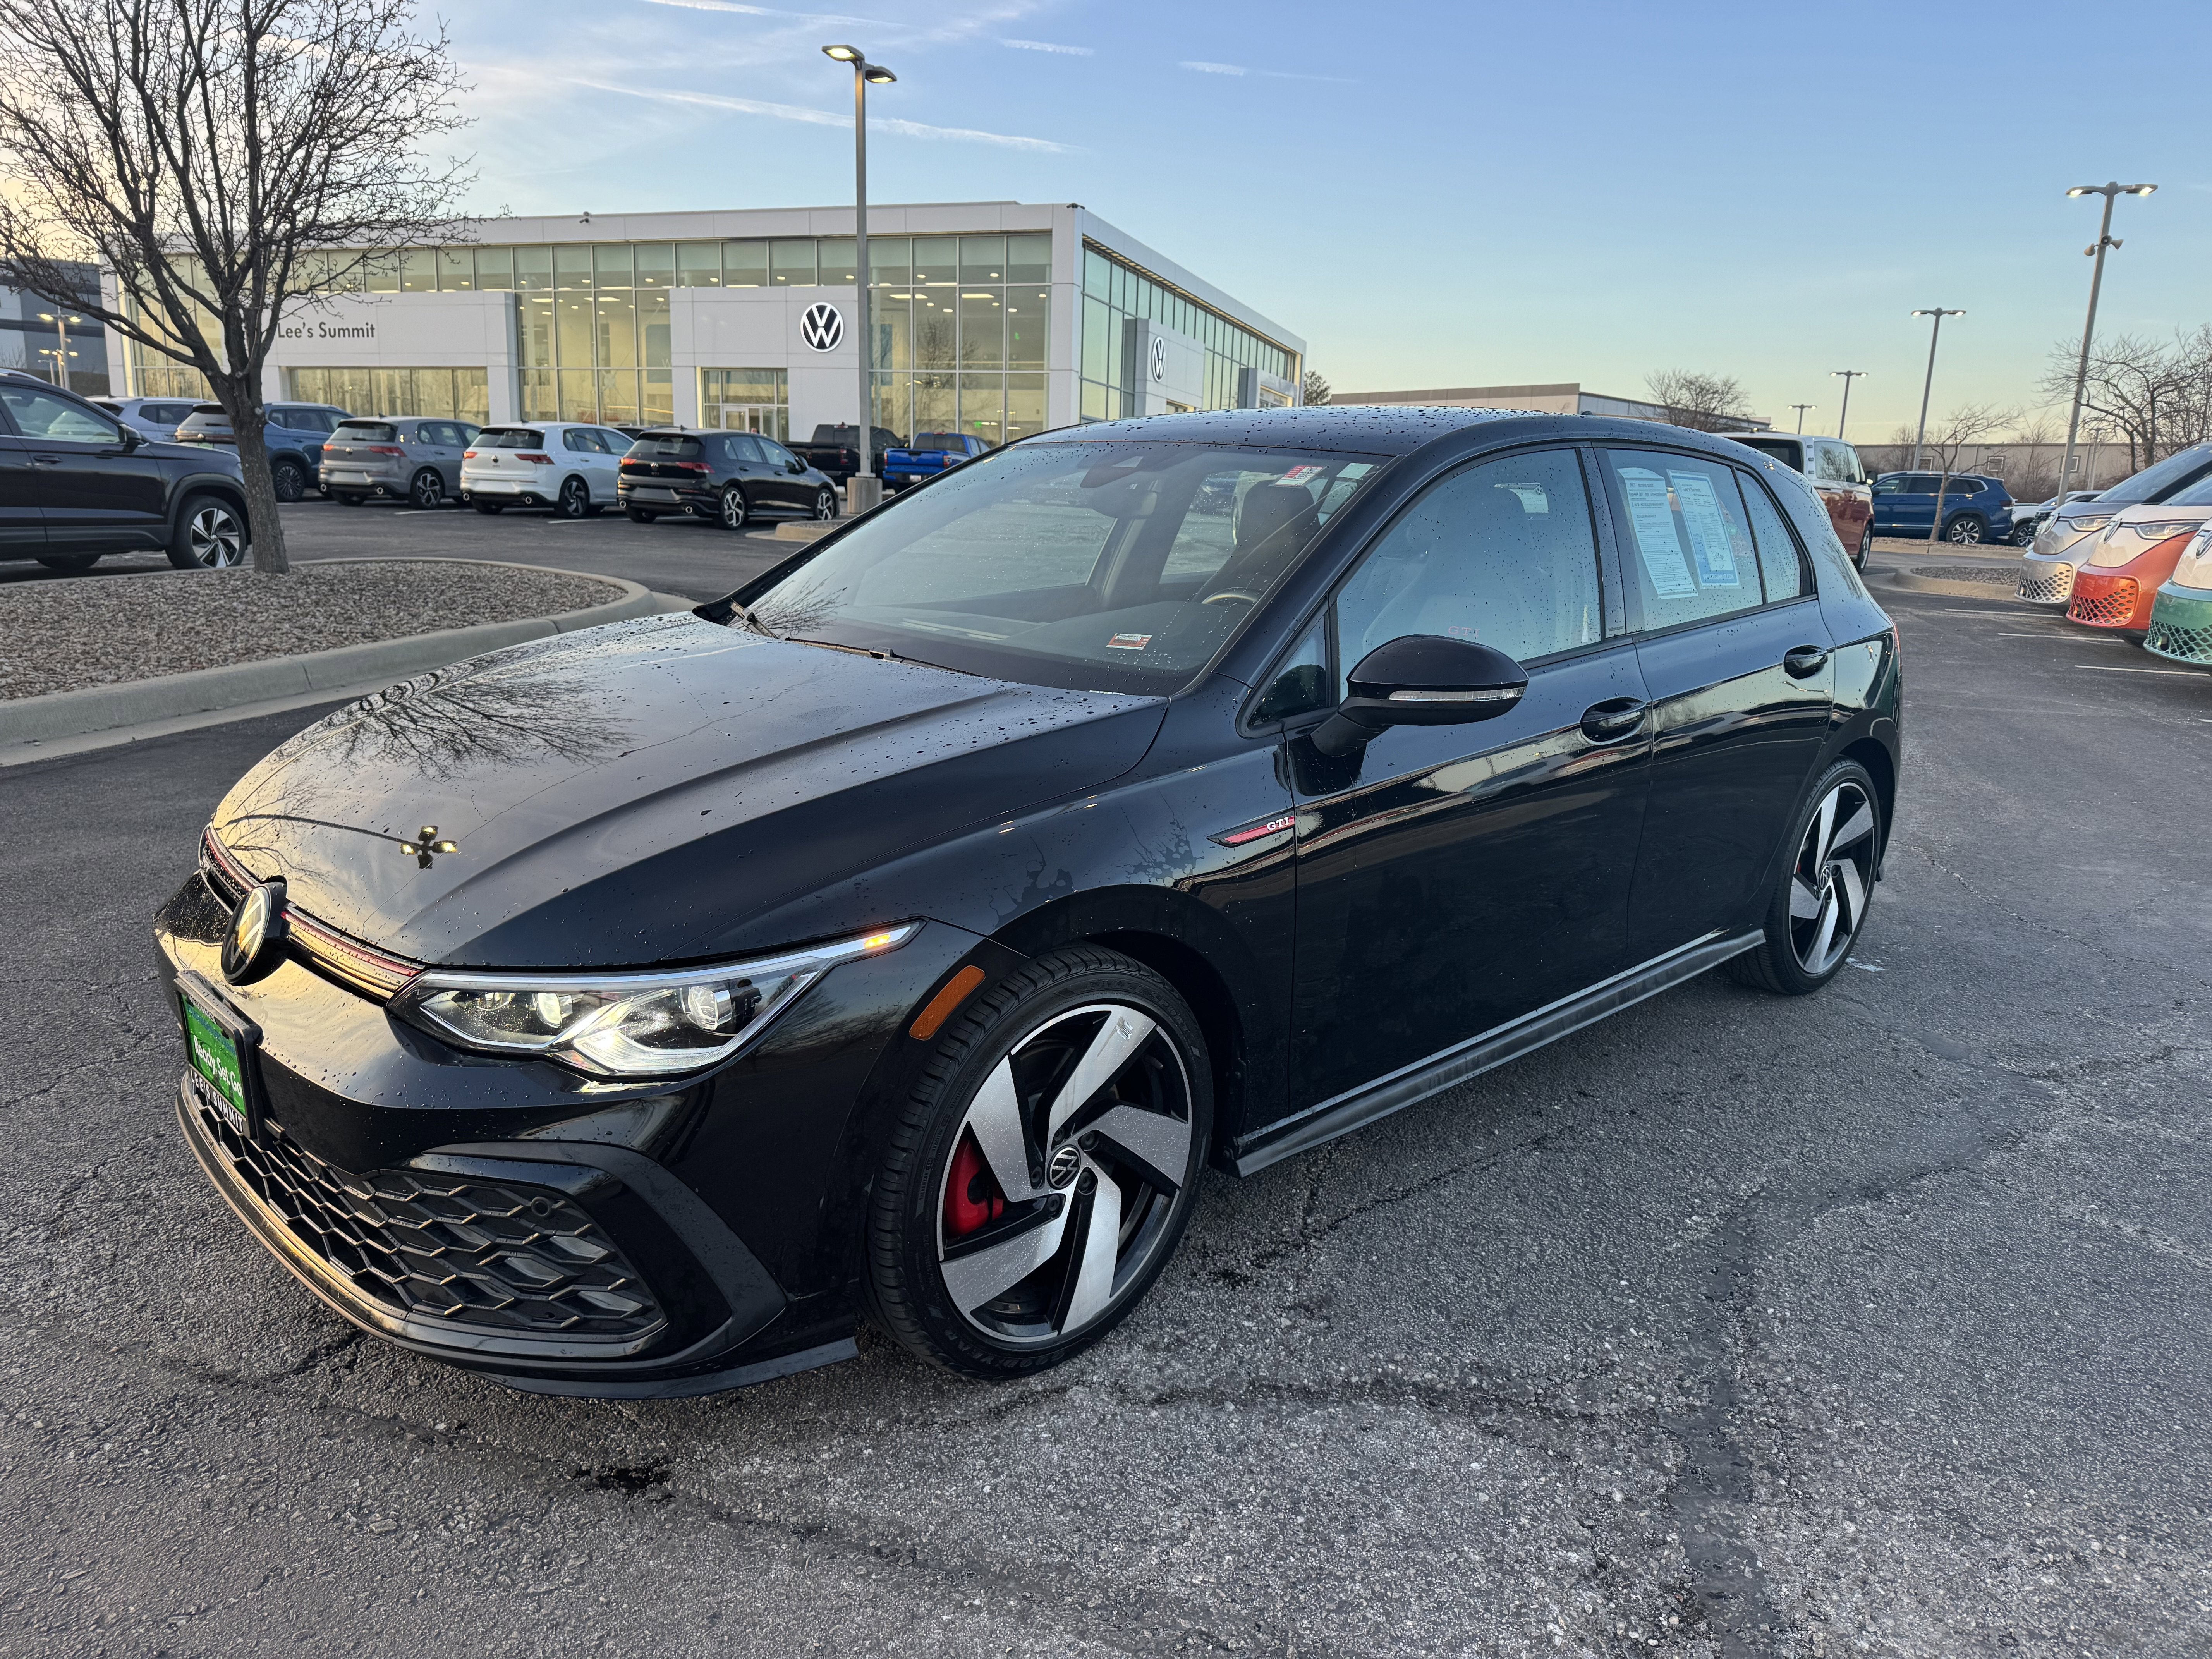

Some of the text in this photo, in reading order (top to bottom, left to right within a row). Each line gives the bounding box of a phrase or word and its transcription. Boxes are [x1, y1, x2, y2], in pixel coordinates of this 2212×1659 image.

[277, 321, 375, 338] Lee's Summit
[1448, 625, 1480, 637] GTI
[1267, 816, 1290, 831] GTI
[190, 1068, 242, 1134] LEE'S SUMMIT
